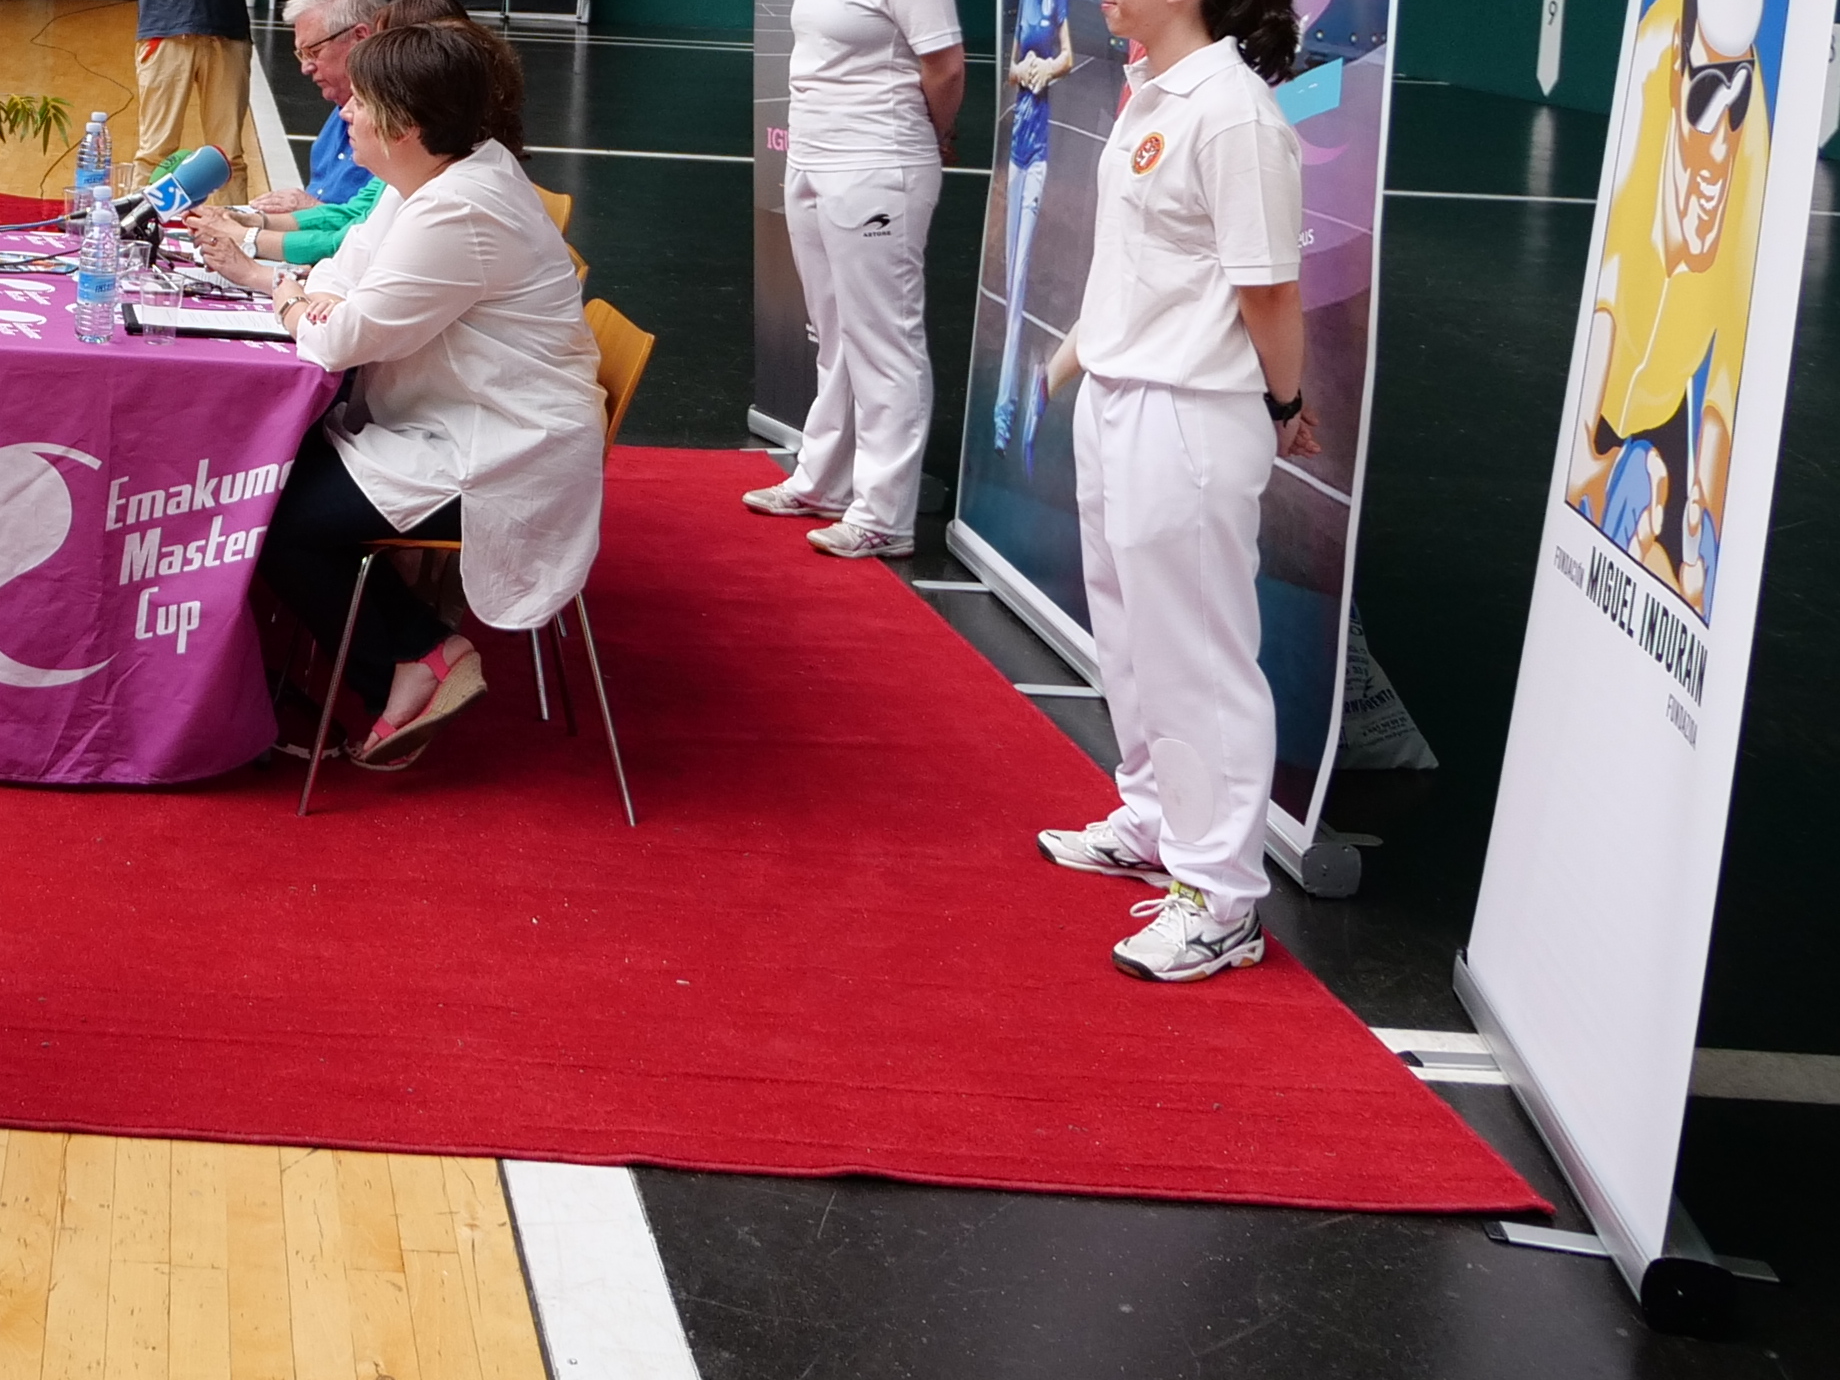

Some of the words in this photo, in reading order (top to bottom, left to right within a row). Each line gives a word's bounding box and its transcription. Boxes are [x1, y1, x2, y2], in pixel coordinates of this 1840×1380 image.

[1548, 0, 1558, 26] 9
[119, 515, 268, 586] Master
[135, 586, 201, 654] Cup
[1586, 545, 1638, 639] MIGUEL
[1638, 592, 1708, 708] INDURAIN
